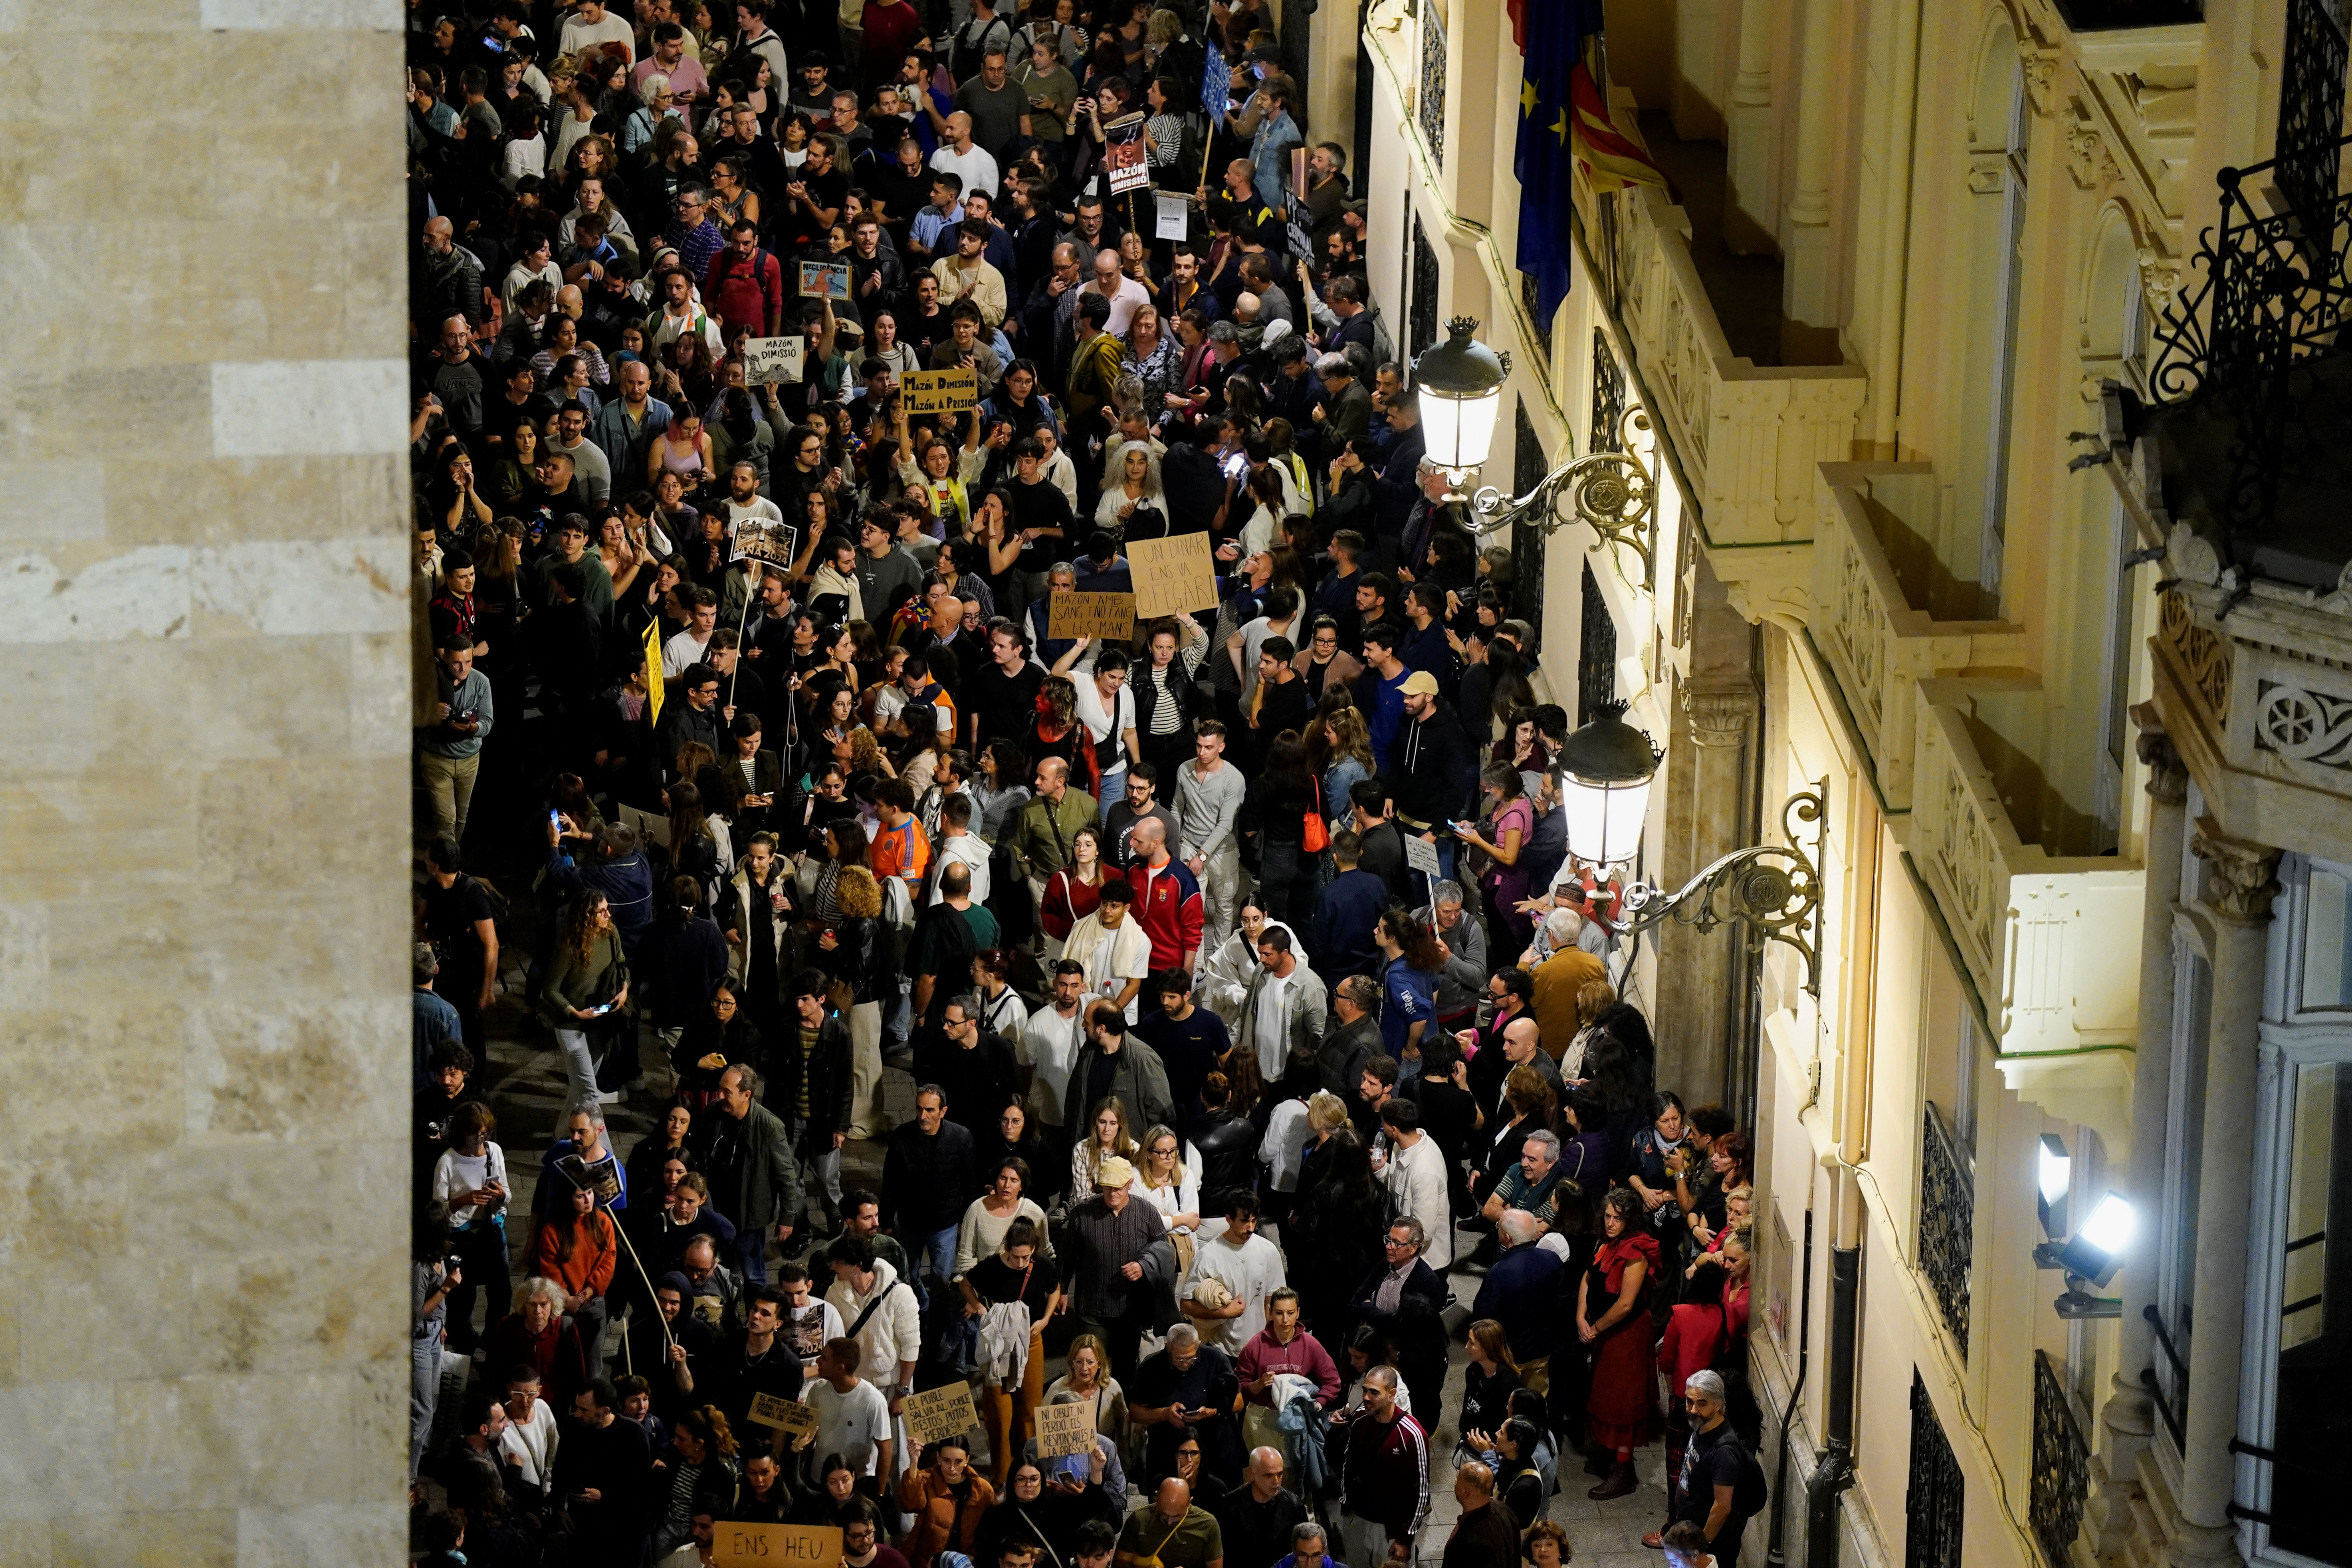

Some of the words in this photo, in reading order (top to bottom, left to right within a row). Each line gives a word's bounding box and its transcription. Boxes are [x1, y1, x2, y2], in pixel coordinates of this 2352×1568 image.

[1110, 162, 1146, 182] MAZÓN
[1111, 173, 1147, 192] DIMISSIÓ
[766, 339, 792, 348] MAZÓN
[761, 347, 796, 359] DIMISSIÓ
[440, 377, 474, 391] VANS
[904, 377, 933, 391] MAZÓN
[938, 374, 975, 390] DIMISIÓN
[904, 394, 935, 410] MAZÓN
[938, 398, 944, 409] A
[947, 393, 977, 409] PRISIÓN
[1142, 542, 1163, 563] UN
[1168, 533, 1205, 558] DINAR
[764, 550, 787, 565] 2024
[1150, 565, 1173, 581] ENS
[1177, 561, 1191, 576] VA
[1098, 595, 1123, 605] AMB
[1139, 574, 1215, 613] OFEGAR!
[1054, 605, 1082, 620] SANG
[1094, 605, 1106, 618] NO
[1109, 605, 1134, 623] FANG
[1053, 622, 1062, 636] A
[1072, 620, 1092, 639] LES
[1099, 621, 1129, 638] MANS
[799, 1340, 823, 1355] 2024
[908, 1398, 918, 1410] EL
[920, 1389, 944, 1406] POBLE
[910, 1406, 935, 1421] SALVA
[936, 1403, 948, 1413] AL
[949, 1393, 971, 1408] POBLE
[1470, 1398, 1481, 1412] YORK
[945, 1405, 969, 1424] PUTOS
[1041, 1407, 1049, 1420] NI
[1077, 1403, 1084, 1415] NI
[924, 1421, 963, 1443] MERDES!!
[1070, 1417, 1081, 1429] ELS
[1043, 1428, 1088, 1447] RESPONSABLES
[1090, 1428, 1095, 1441] A
[1048, 1447, 1058, 1457] LA
[734, 1532, 769, 1557] ENS
[785, 1536, 823, 1560] HEU
